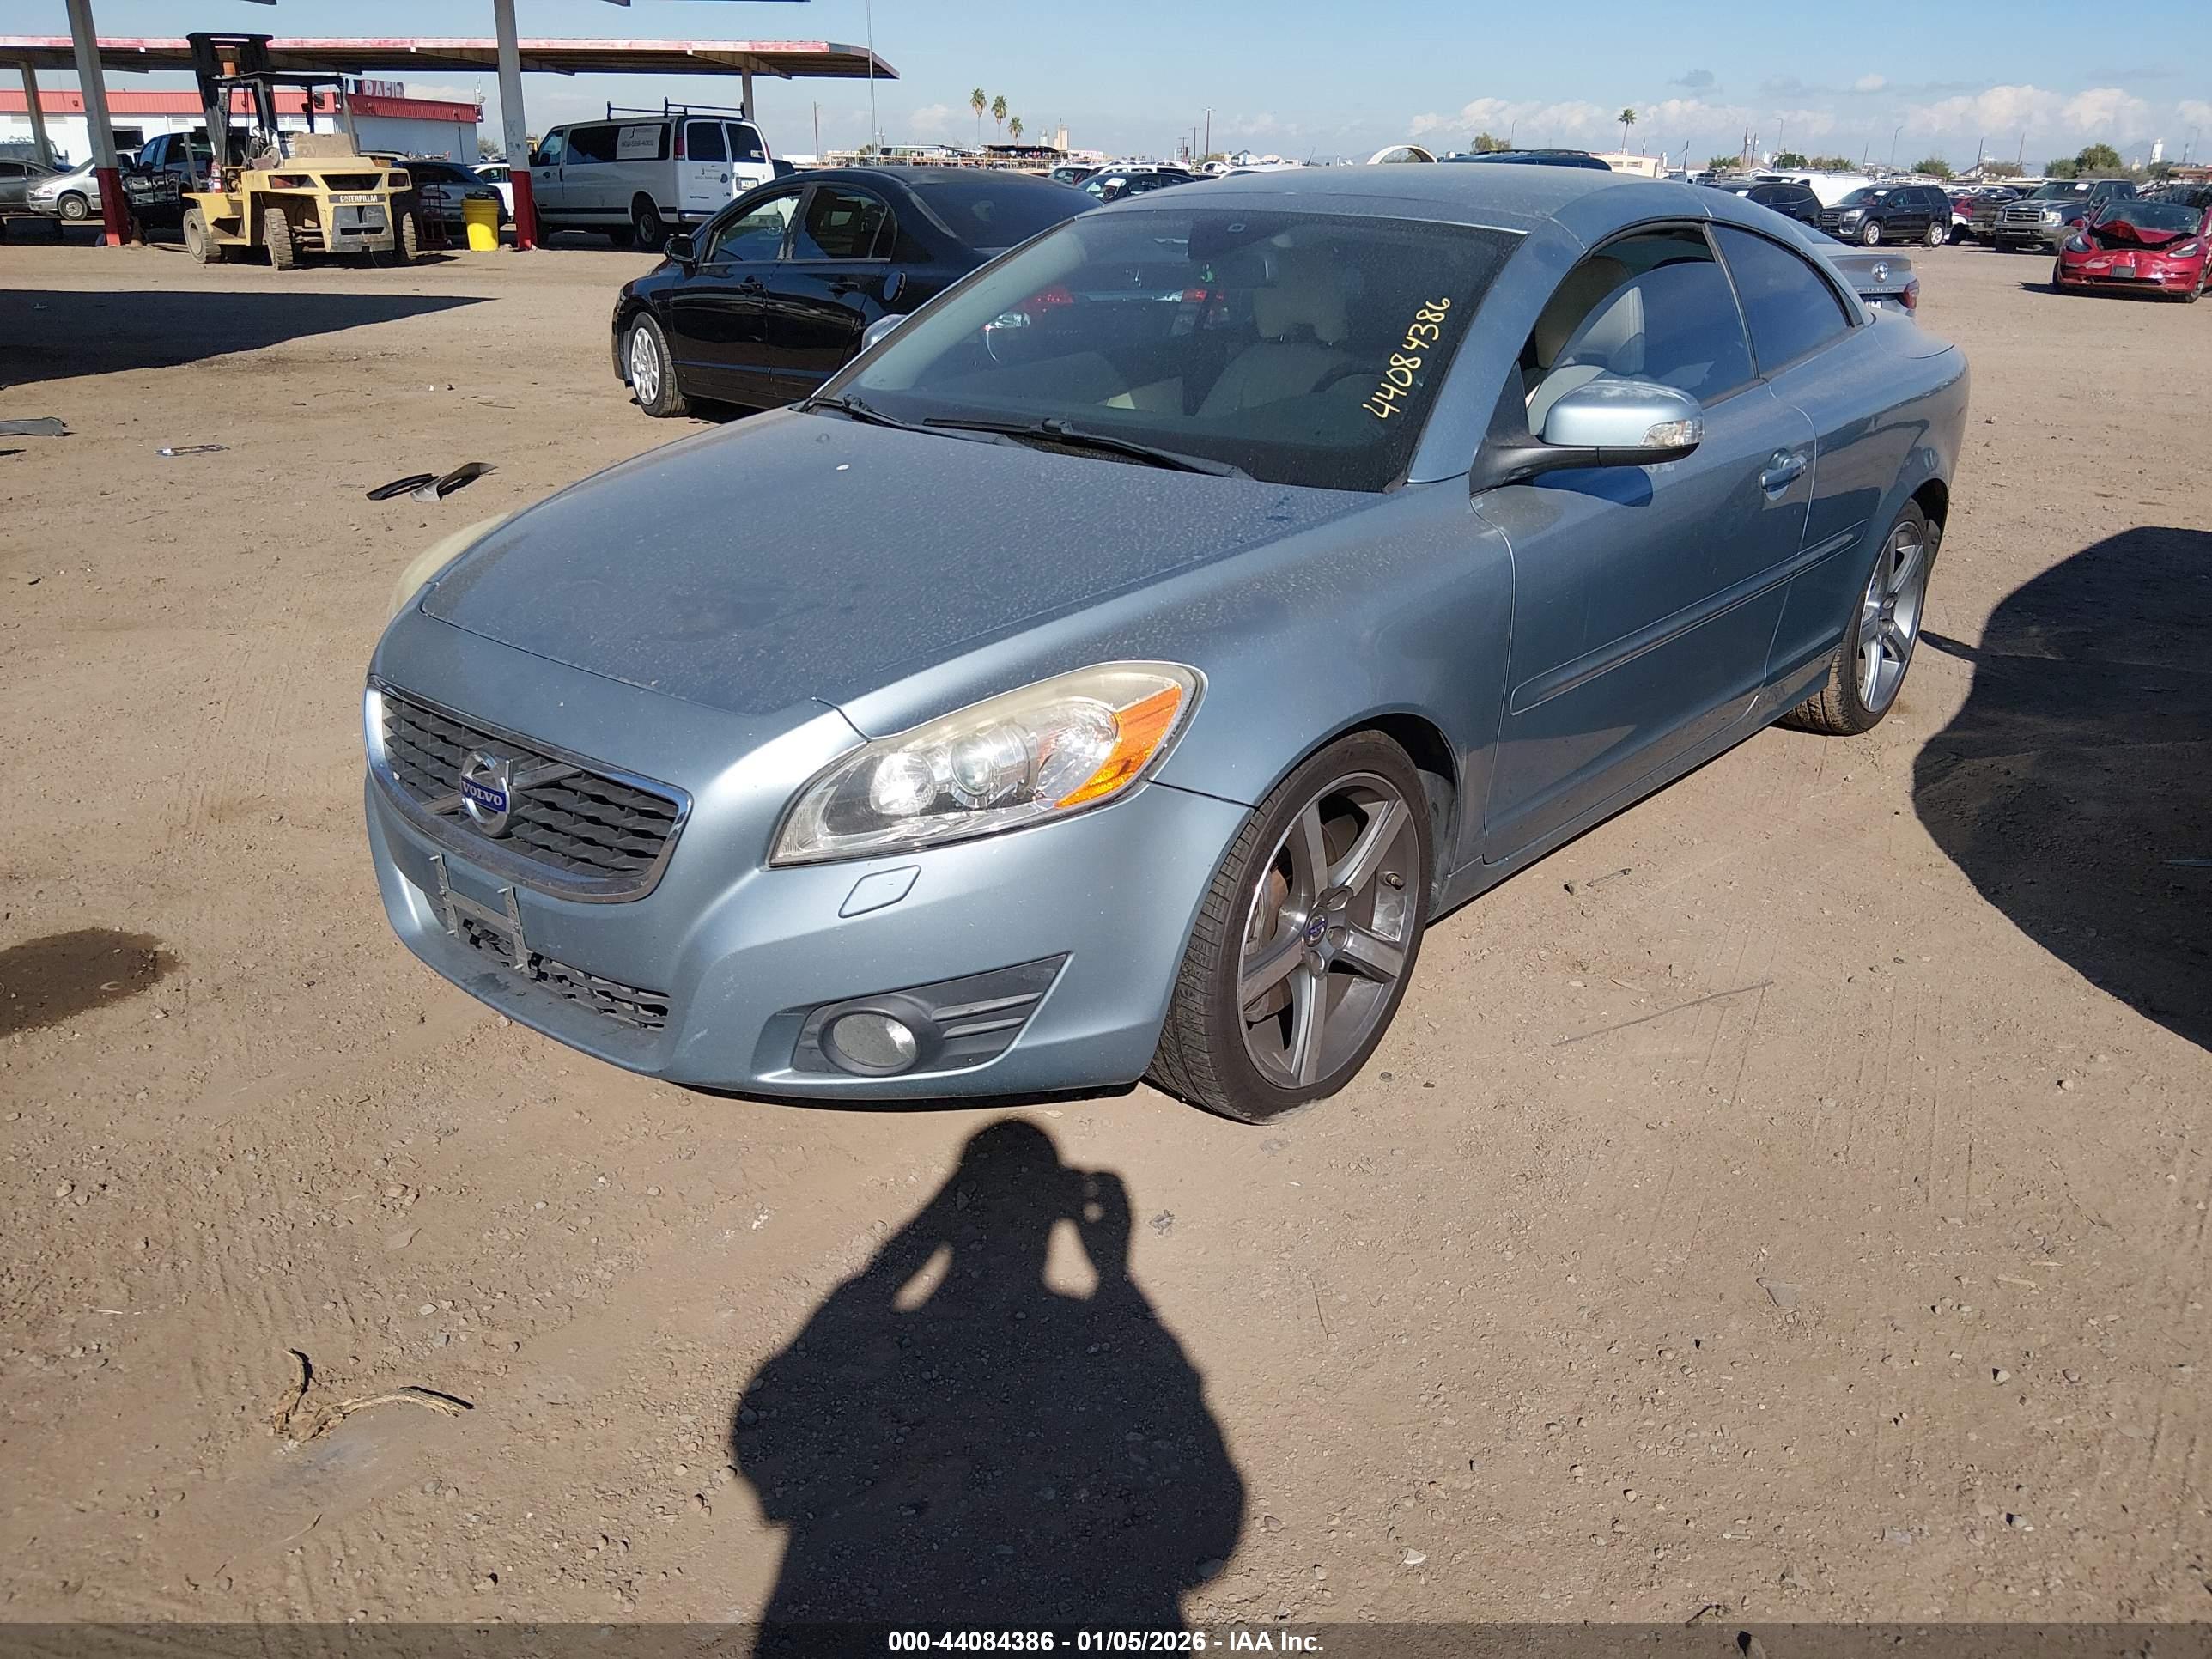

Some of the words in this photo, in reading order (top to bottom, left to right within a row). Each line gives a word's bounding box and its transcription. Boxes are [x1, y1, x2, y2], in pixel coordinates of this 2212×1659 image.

[339, 194, 378, 204] CATERPILLAR
[1362, 297, 1451, 419] 44084386
[462, 781, 504, 806] VOLVO
